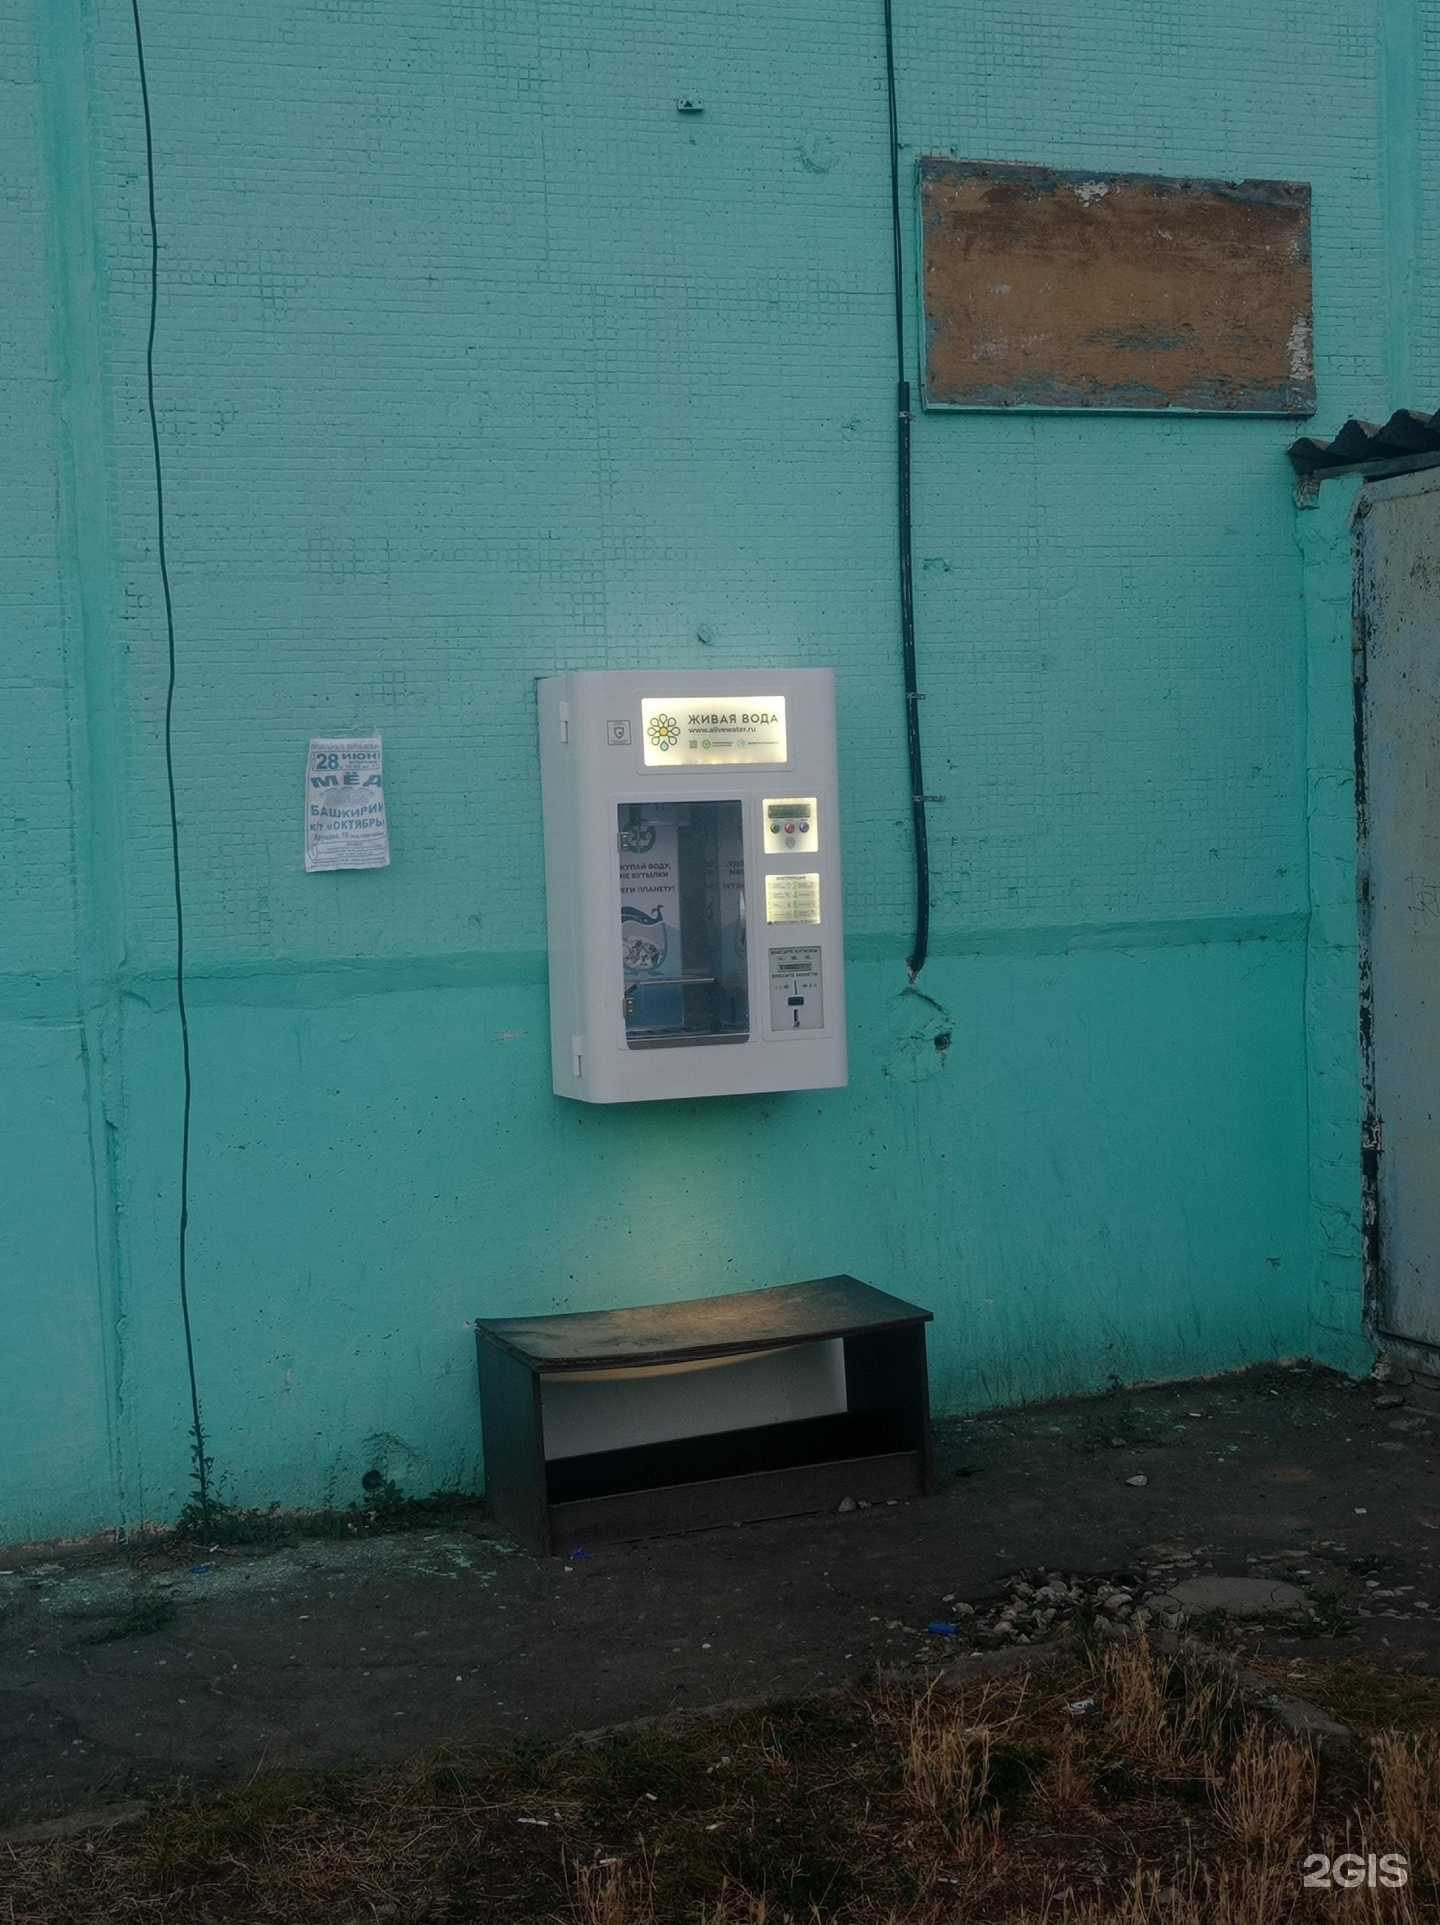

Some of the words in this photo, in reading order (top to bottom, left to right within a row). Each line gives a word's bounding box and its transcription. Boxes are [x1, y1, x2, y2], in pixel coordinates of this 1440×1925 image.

[688, 714, 737, 724] ЖИВАЯ
[742, 713, 778, 724] ВОДА
[316, 753, 339, 769] 28
[310, 772, 382, 788] МЁД
